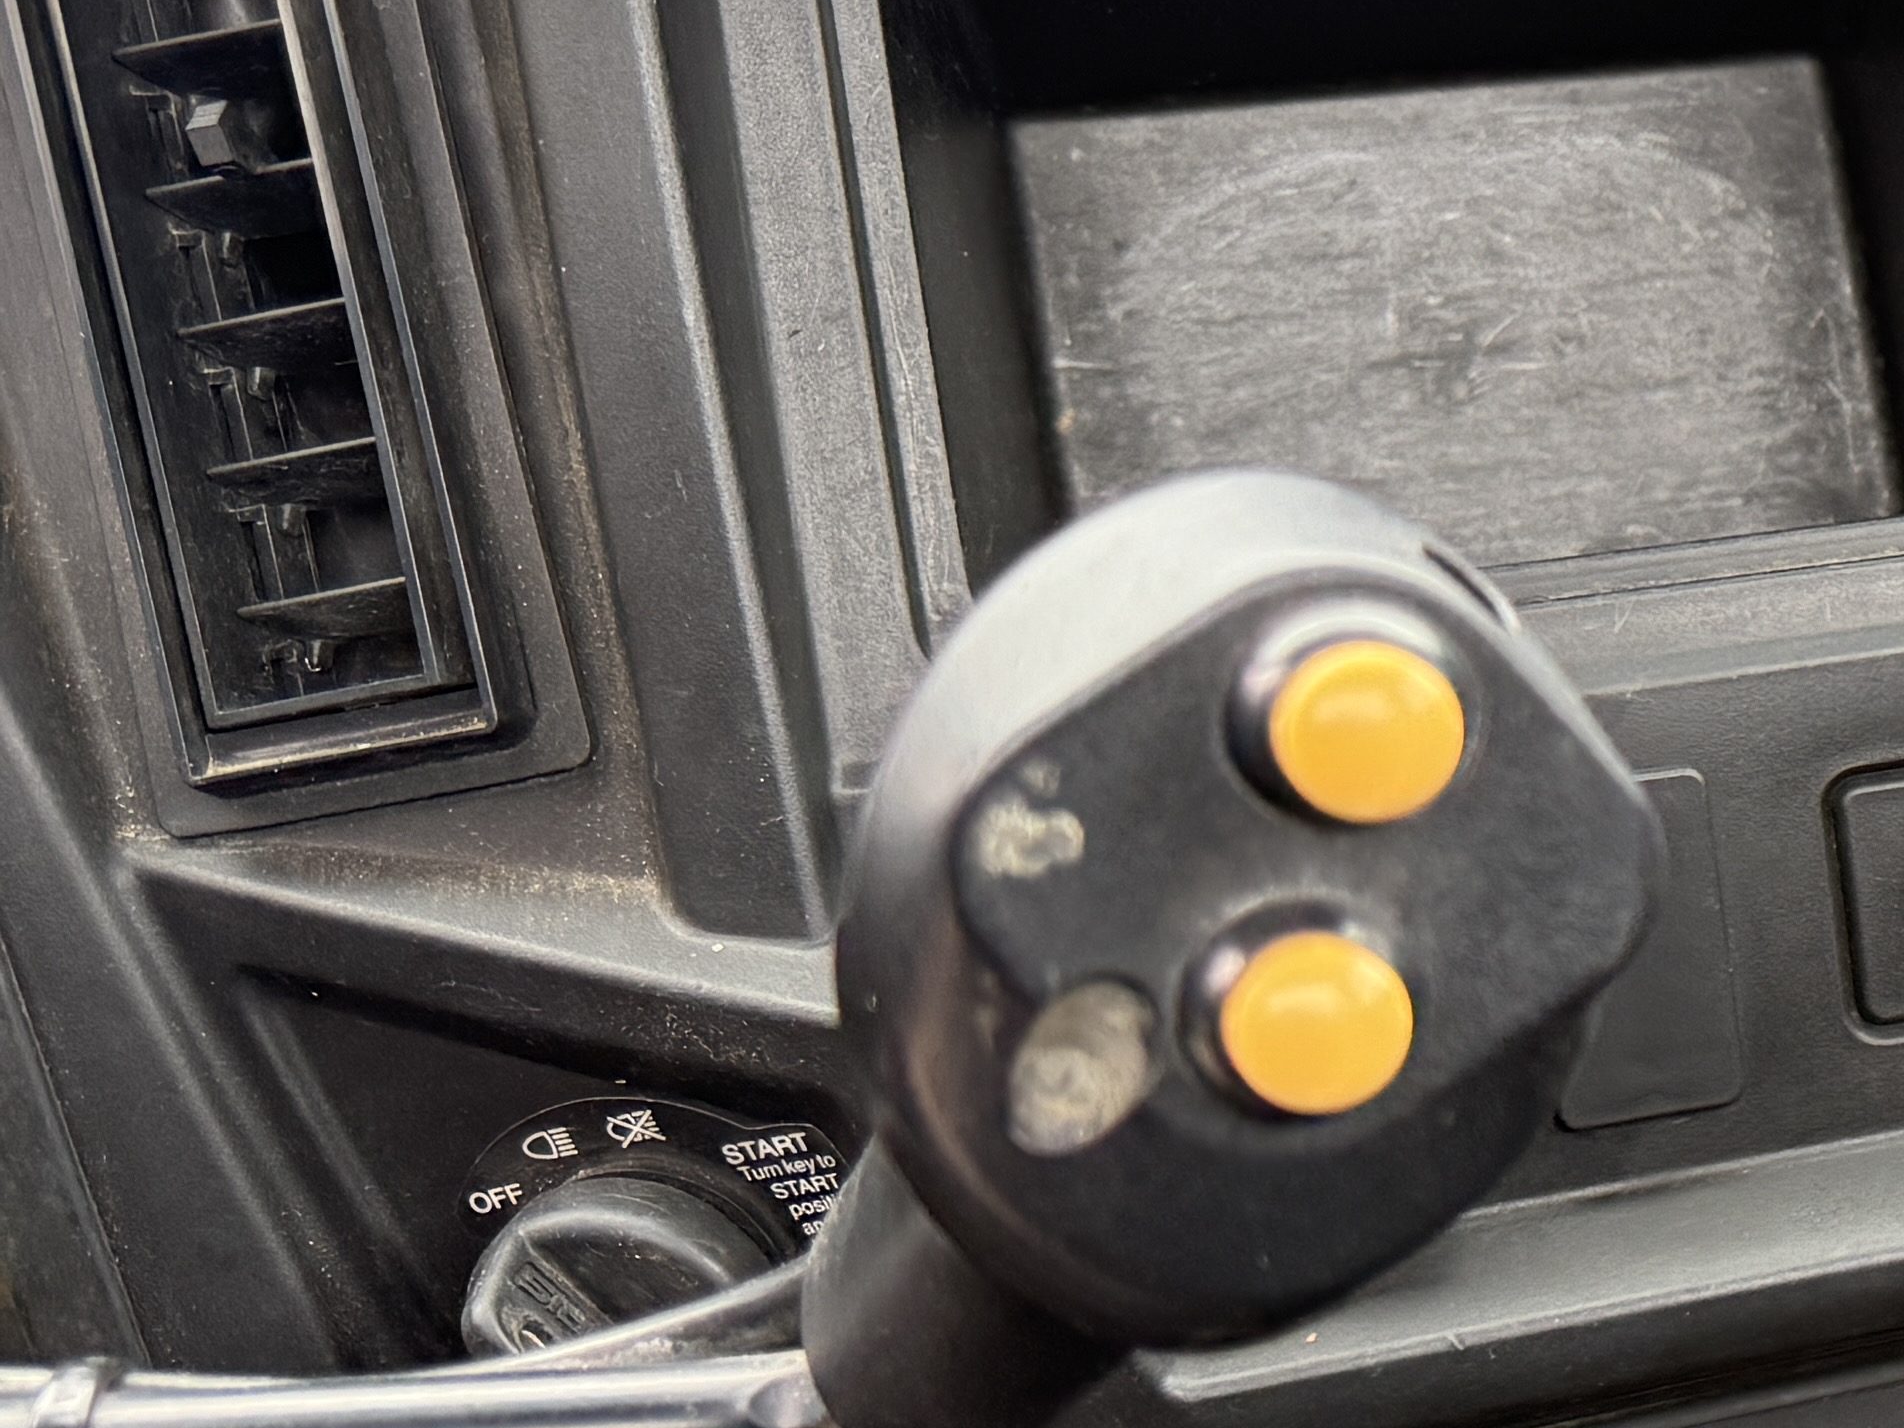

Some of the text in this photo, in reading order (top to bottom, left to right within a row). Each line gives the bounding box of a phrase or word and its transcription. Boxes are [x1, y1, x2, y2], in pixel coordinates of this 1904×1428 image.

[721, 1131, 808, 1165] START
[736, 1154, 836, 1182] Turn key to
[468, 1182, 523, 1214] OFF
[769, 1173, 839, 1200] START
